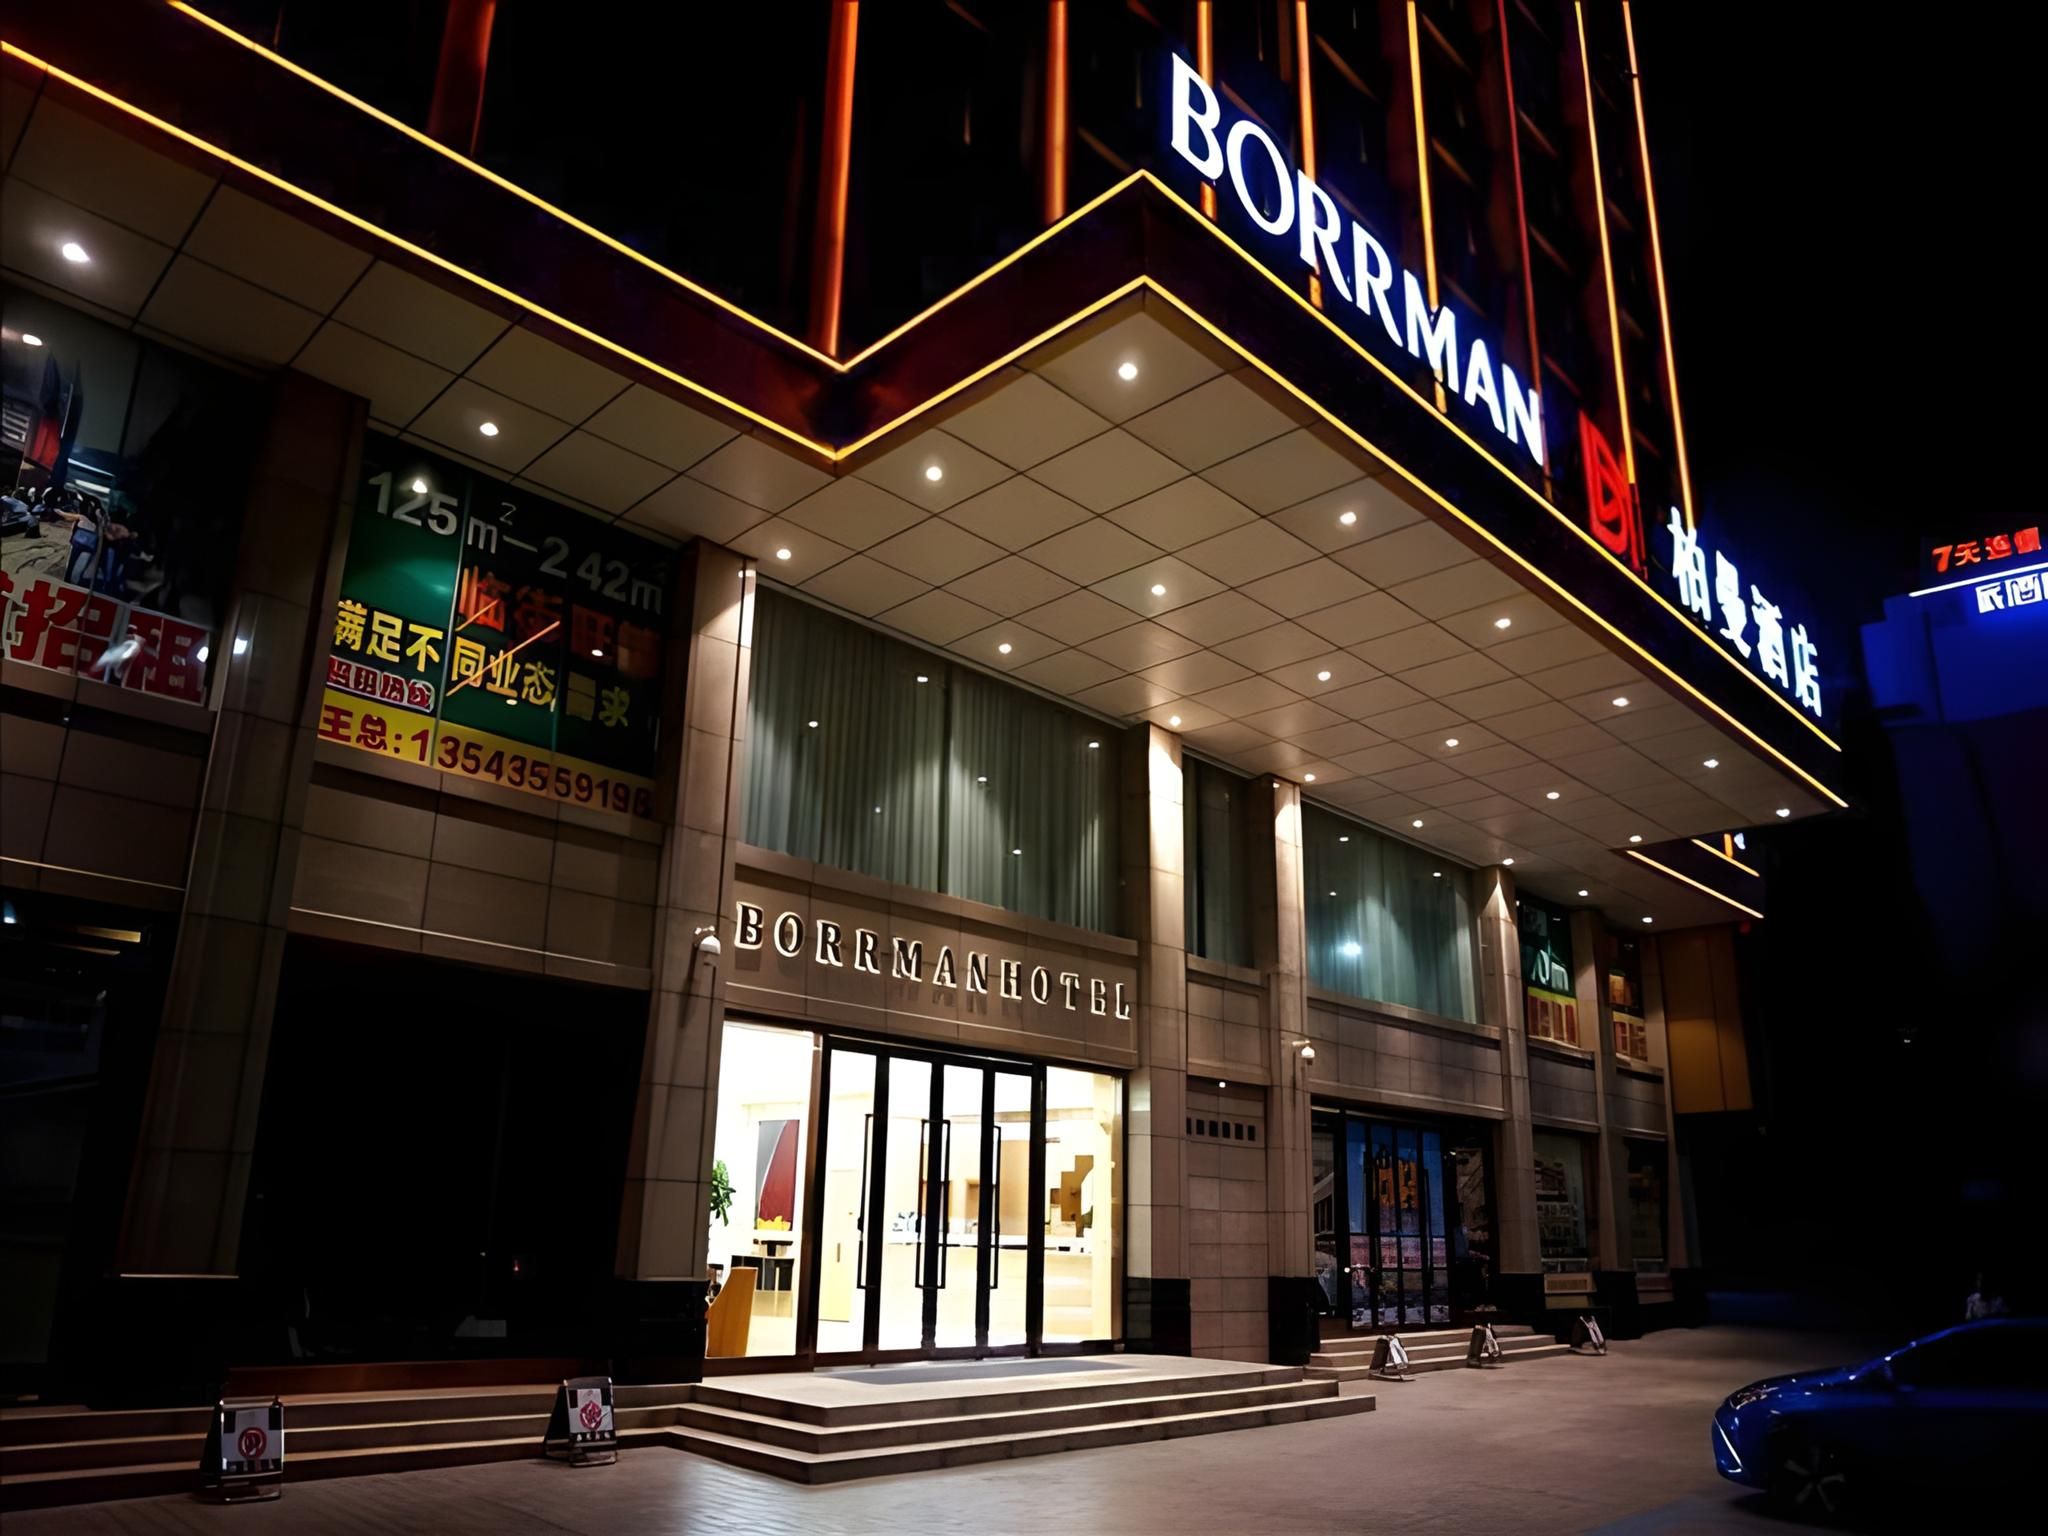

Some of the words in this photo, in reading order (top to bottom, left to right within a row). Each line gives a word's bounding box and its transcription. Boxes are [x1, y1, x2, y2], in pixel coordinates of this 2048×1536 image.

[1171, 52, 1544, 466] BORRMAN
[336, 598, 632, 730] 满足不同业态求
[1667, 505, 1822, 718] 柏曼酒店
